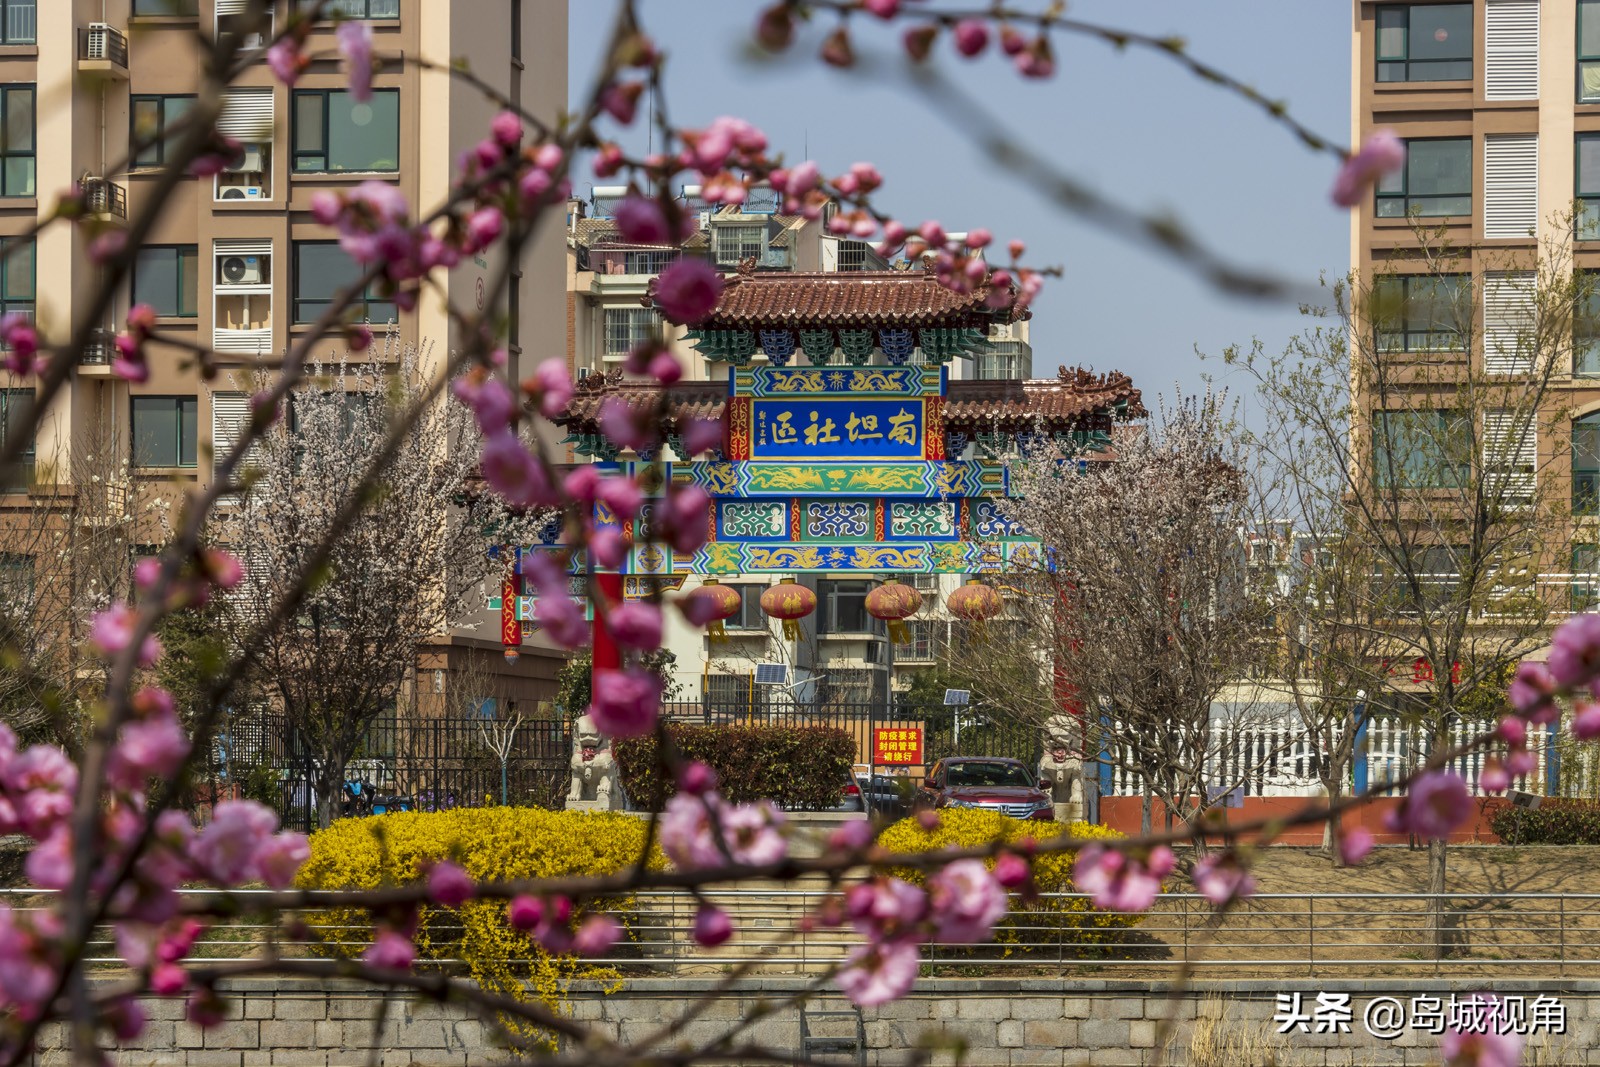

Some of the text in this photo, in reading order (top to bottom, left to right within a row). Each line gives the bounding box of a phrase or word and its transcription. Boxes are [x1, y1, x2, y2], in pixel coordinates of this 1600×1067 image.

[879, 731, 917, 741] 防疫要求
[879, 741, 917, 751] 封闭管理
[884, 751, 913, 762] 请绕行
